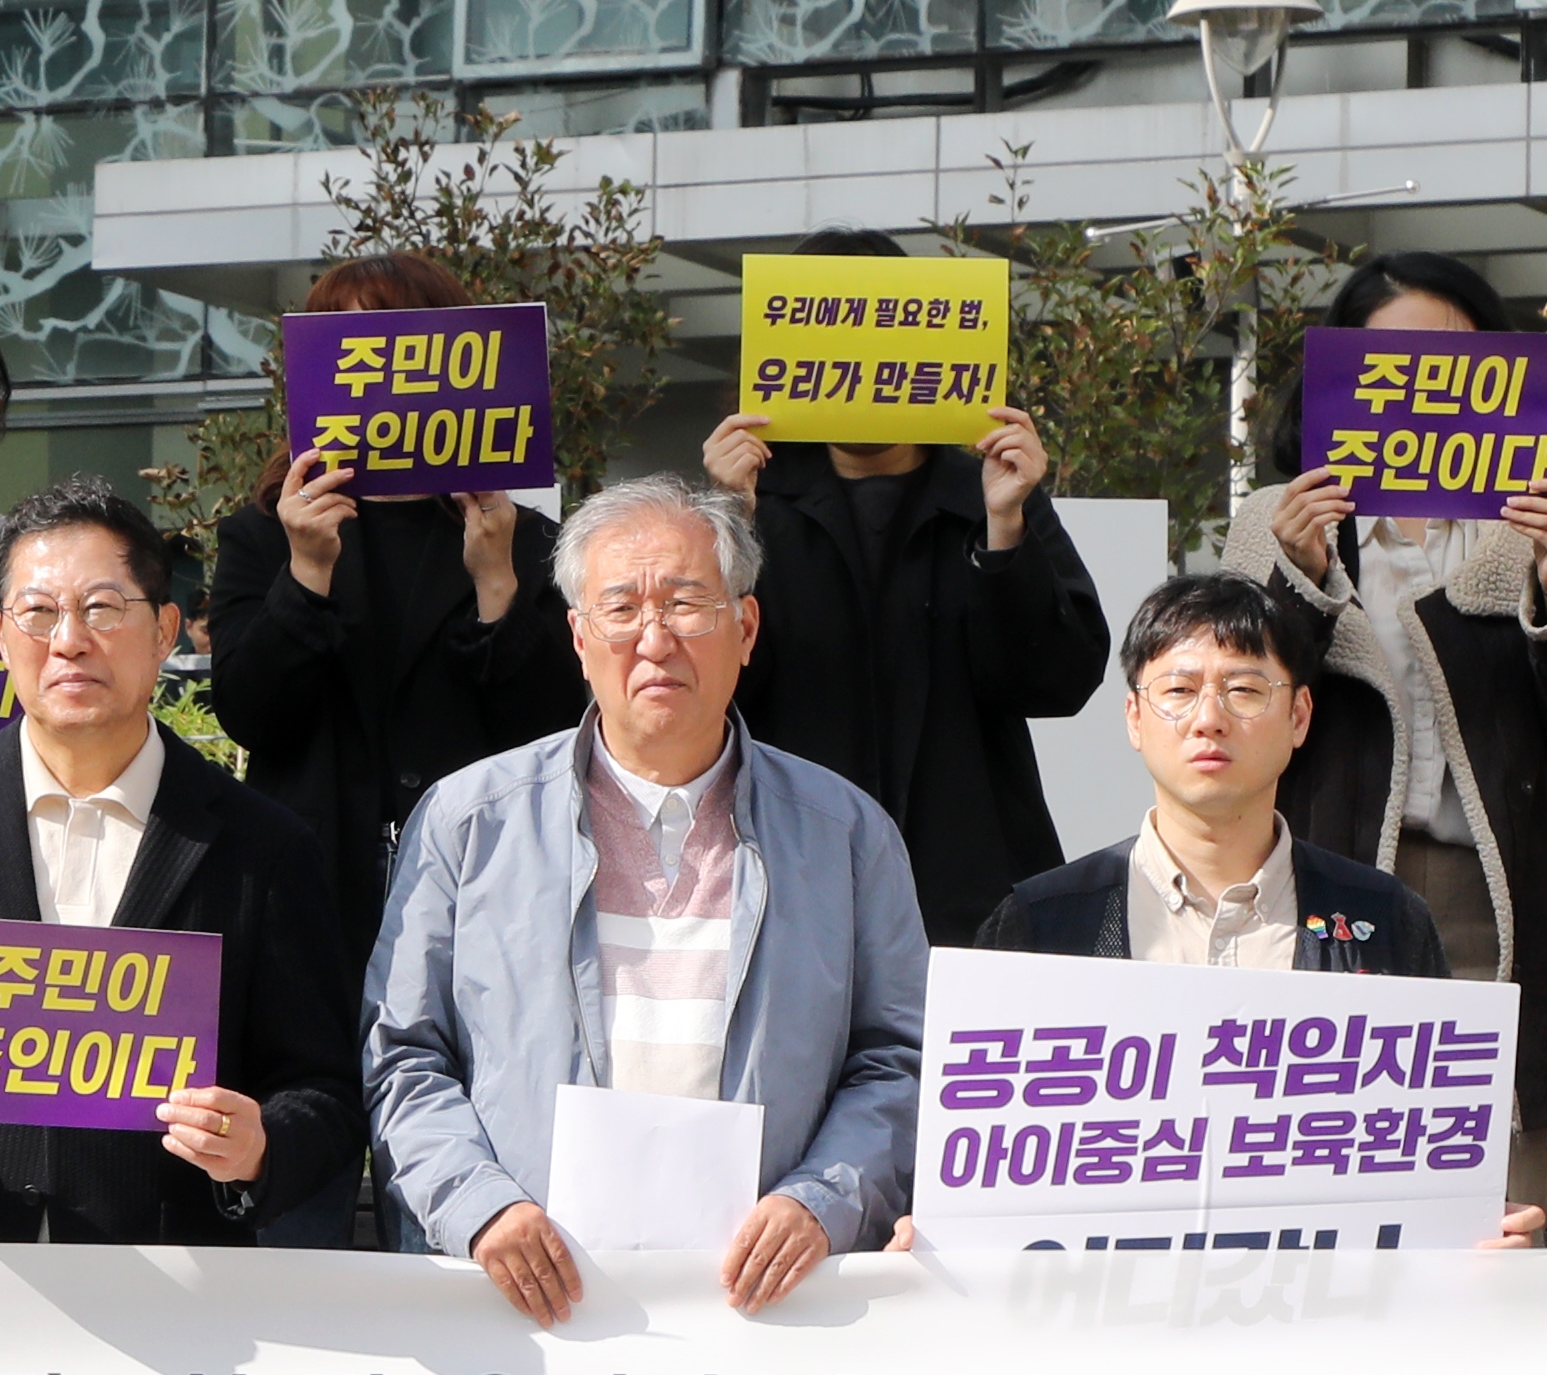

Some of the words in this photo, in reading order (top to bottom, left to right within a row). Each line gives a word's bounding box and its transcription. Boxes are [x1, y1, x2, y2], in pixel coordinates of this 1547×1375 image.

[767, 297, 865, 325] 우리에게
[878, 300, 949, 327] 필요한
[961, 303, 989, 332] 법,
[335, 331, 501, 396] 주민이
[755, 360, 860, 399] 우리가
[875, 363, 994, 403] 만들자!
[1355, 354, 1528, 416] 주민이
[314, 406, 533, 473] 주인이다
[941, 1027, 1175, 1111] 공공이
[1202, 1015, 1500, 1097] 책임지는
[941, 1117, 1208, 1189] 아이중심
[1224, 1105, 1492, 1180] 보육환경
